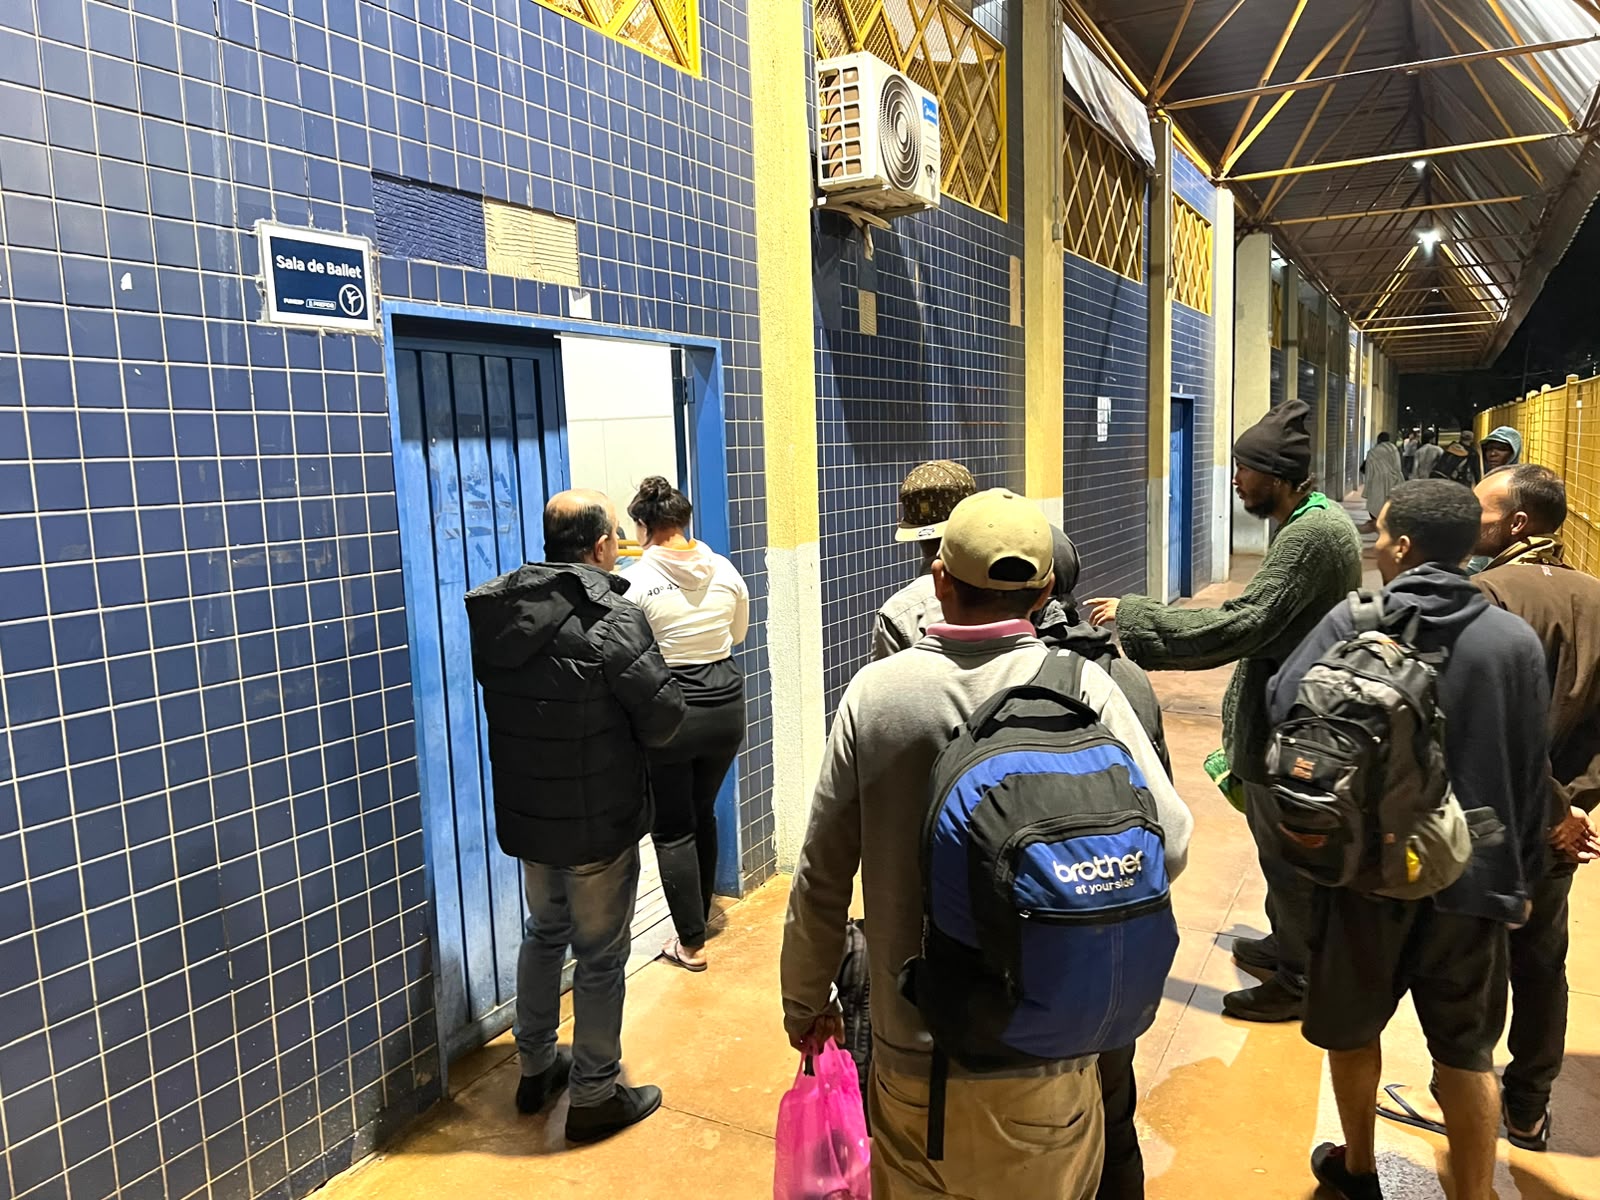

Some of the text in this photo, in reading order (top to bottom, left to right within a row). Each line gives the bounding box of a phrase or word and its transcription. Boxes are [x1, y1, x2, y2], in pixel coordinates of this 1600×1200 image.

[276, 254, 363, 279] Sala de Ballet
[1053, 850, 1143, 883] brother
[1075, 884, 1087, 895] at
[1089, 882, 1114, 895] your
